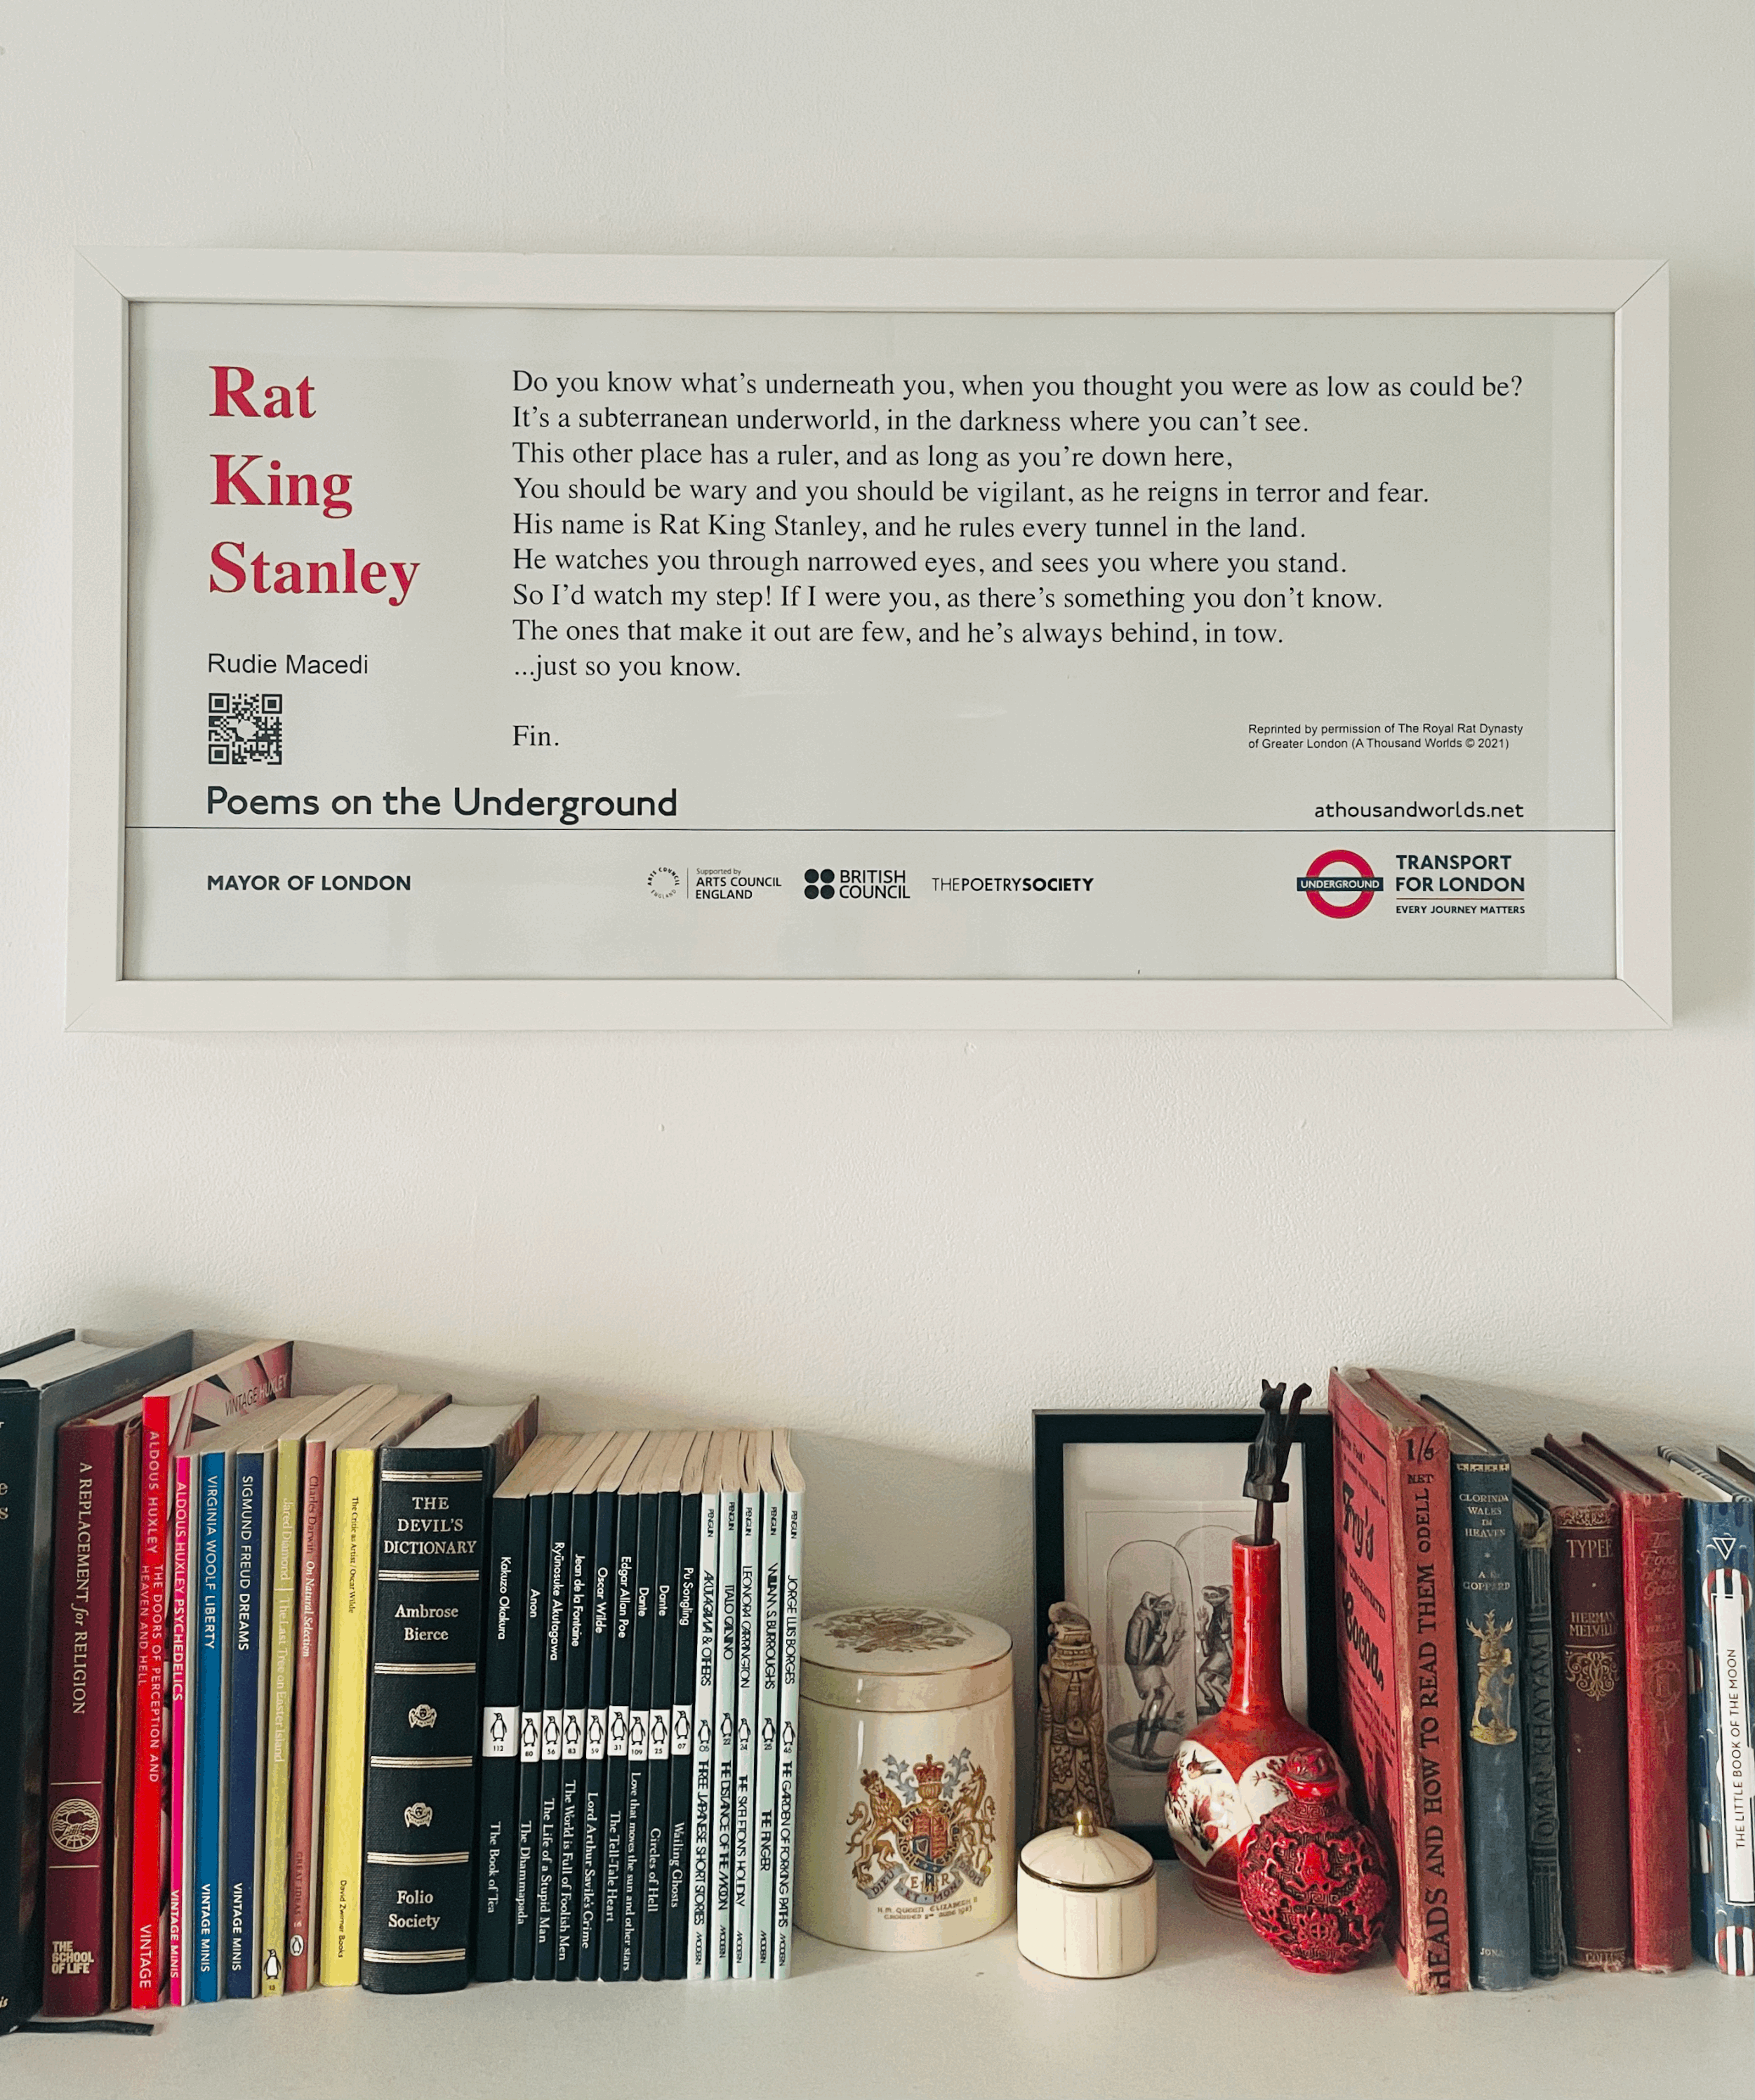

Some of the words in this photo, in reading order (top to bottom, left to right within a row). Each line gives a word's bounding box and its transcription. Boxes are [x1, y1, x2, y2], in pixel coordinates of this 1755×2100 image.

[208, 366, 317, 419] Rat
[512, 369, 548, 392] Do
[556, 377, 599, 398] you
[607, 371, 673, 392] know
[680, 371, 757, 394] what’s
[765, 373, 895, 395] underneath
[903, 380, 954, 401] you,
[962, 374, 1024, 396] when
[1032, 381, 1075, 402] you
[1083, 374, 1173, 402] thought
[1180, 381, 1224, 402] you
[1231, 381, 1287, 396] were
[1295, 381, 1318, 397] as
[1327, 375, 1370, 397] low
[1378, 382, 1401, 397] as
[1410, 375, 1475, 397] could
[1482, 375, 1523, 397] be?
[209, 454, 352, 519] King
[209, 541, 421, 607] Stanley
[208, 653, 277, 674] Rudie
[286, 654, 368, 674] Macedi
[512, 725, 559, 746] Fin.
[1248, 724, 1301, 737] Reprinted
[1304, 724, 1318, 737] by
[1321, 723, 1381, 737] permission
[1384, 722, 1396, 734] of
[1397, 722, 1419, 734] The
[1422, 722, 1454, 736] Royal
[1457, 722, 1476, 734] Rat
[1480, 723, 1523, 737] Dynasty
[1248, 738, 1259, 749] of
[1261, 738, 1304, 749] Greater
[1306, 738, 1348, 748] London
[1351, 738, 1365, 750] (A
[1366, 738, 1422, 748] Thousand
[1424, 737, 1462, 748] Worlds
[1465, 737, 1476, 748] ©
[1478, 738, 1509, 751] 2021)
[207, 786, 319, 815] Poems
[331, 795, 371, 815] on
[383, 786, 441, 816] the
[454, 787, 677, 826] Underground
[1314, 800, 1524, 818] athousandworlds.net
[696, 867, 731, 876] Supported
[733, 868, 741, 876] by
[1396, 854, 1512, 870] TRANSPORT
[207, 875, 280, 891] MAYOR
[287, 875, 315, 891] OF
[322, 875, 411, 891] LONDON
[647, 870, 657, 886] ARTS
[658, 867, 680, 886] COUNCIL
[696, 876, 727, 887] ARTS
[730, 876, 782, 887] COUNCIL
[840, 869, 906, 884] BRITISH
[1300, 880, 1379, 889] UNDERGROUND
[1396, 876, 1434, 892] FOR
[1439, 876, 1525, 892] LONDON
[651, 889, 677, 899] ENGLAND
[695, 889, 753, 899] ENGLAND
[839, 885, 911, 899] COUNCIL
[1396, 905, 1427, 914] EVERY
[1430, 905, 1478, 914] JOURNEY
[1480, 906, 1525, 914] MATTERS
[79, 1461, 93, 1474] A
[148, 1432, 159, 1490] ALDOUS
[1408, 1474, 1433, 1484] NET
[206, 1475, 218, 1536] VIRGINIA
[241, 1475, 253, 1540] SIGMUND
[309, 1476, 319, 1515] Charles
[411, 1496, 449, 1510] THE
[1459, 1493, 1509, 1503] CLORINDA
[147, 1497, 158, 1553] HUXLEY
[1415, 1488, 1431, 1554] ODELL
[1467, 1506, 1502, 1516] WALES
[307, 1517, 317, 1554] Darwin
[397, 1518, 463, 1533] DEVIL’S
[1464, 1528, 1506, 1538] HEAVEN
[76, 1479, 92, 1603] REPLACEMENT
[383, 1540, 477, 1554] DICTIONARY
[1566, 1538, 1614, 1559] TYPEE
[205, 1540, 217, 1590] WOOLF
[239, 1545, 252, 1589] FREUD
[305, 1560, 315, 1575] On
[499, 1557, 512, 1594] Kakuzo
[550, 1542, 565, 1597] Ryūnosuke
[618, 1556, 633, 1587] Edgar
[683, 1567, 694, 1580] Pu
[304, 1576, 314, 1615] Natural
[597, 1566, 609, 1599] Oscar
[395, 1604, 459, 1618] Ambrose
[619, 1587, 630, 1616] Allan
[679, 1581, 694, 1626] Songling
[1417, 1564, 1438, 1635] THEM
[71, 1602, 89, 1626] for
[204, 1595, 216, 1649] LIBERTY
[238, 1593, 251, 1651] DREAMS
[498, 1596, 510, 1640] Okakura
[595, 1602, 607, 1634] Wilde
[303, 1616, 314, 1658] Selection
[404, 1627, 449, 1641] Bierce
[548, 1599, 563, 1661] Akutagawa
[618, 1618, 629, 1639] Poe
[73, 1631, 88, 1714] RELIGION
[1419, 1642, 1438, 1709] READ
[1727, 1649, 1737, 1689] MOON
[1729, 1693, 1740, 1717] THE
[1420, 1716, 1440, 1750] TO
[1731, 1721, 1740, 1737] OF
[1732, 1741, 1742, 1777] BOOK
[1422, 1757, 1443, 1816] HOW
[1734, 1781, 1744, 1821] LITTLE
[489, 1821, 501, 1845] The
[609, 1810, 621, 1833] The
[669, 1822, 685, 1867] Wailing
[1736, 1824, 1746, 1849] THE
[489, 1849, 500, 1877] Book
[607, 1835, 620, 1887] Tell-Tale
[1426, 1825, 1445, 1878] AND
[397, 1889, 434, 1904] Folio
[488, 1879, 498, 1892] of
[671, 1869, 683, 1908] Ghosts
[872, 1870, 894, 1895] DIEU
[232, 1882, 243, 1934] VINTAGE
[487, 1893, 498, 1913] Tea
[606, 1889, 618, 1922] Heart
[388, 1913, 441, 1930] Society
[52, 1941, 74, 1952] THE
[1426, 1887, 1450, 1990] HEADS
[51, 1962, 65, 1974] OF
[67, 1962, 90, 1974] LIFE
[52, 1951, 94, 1963] SCHOOL
[139, 1924, 152, 1988] VINTAGE
[232, 1937, 242, 1971] MINIS
